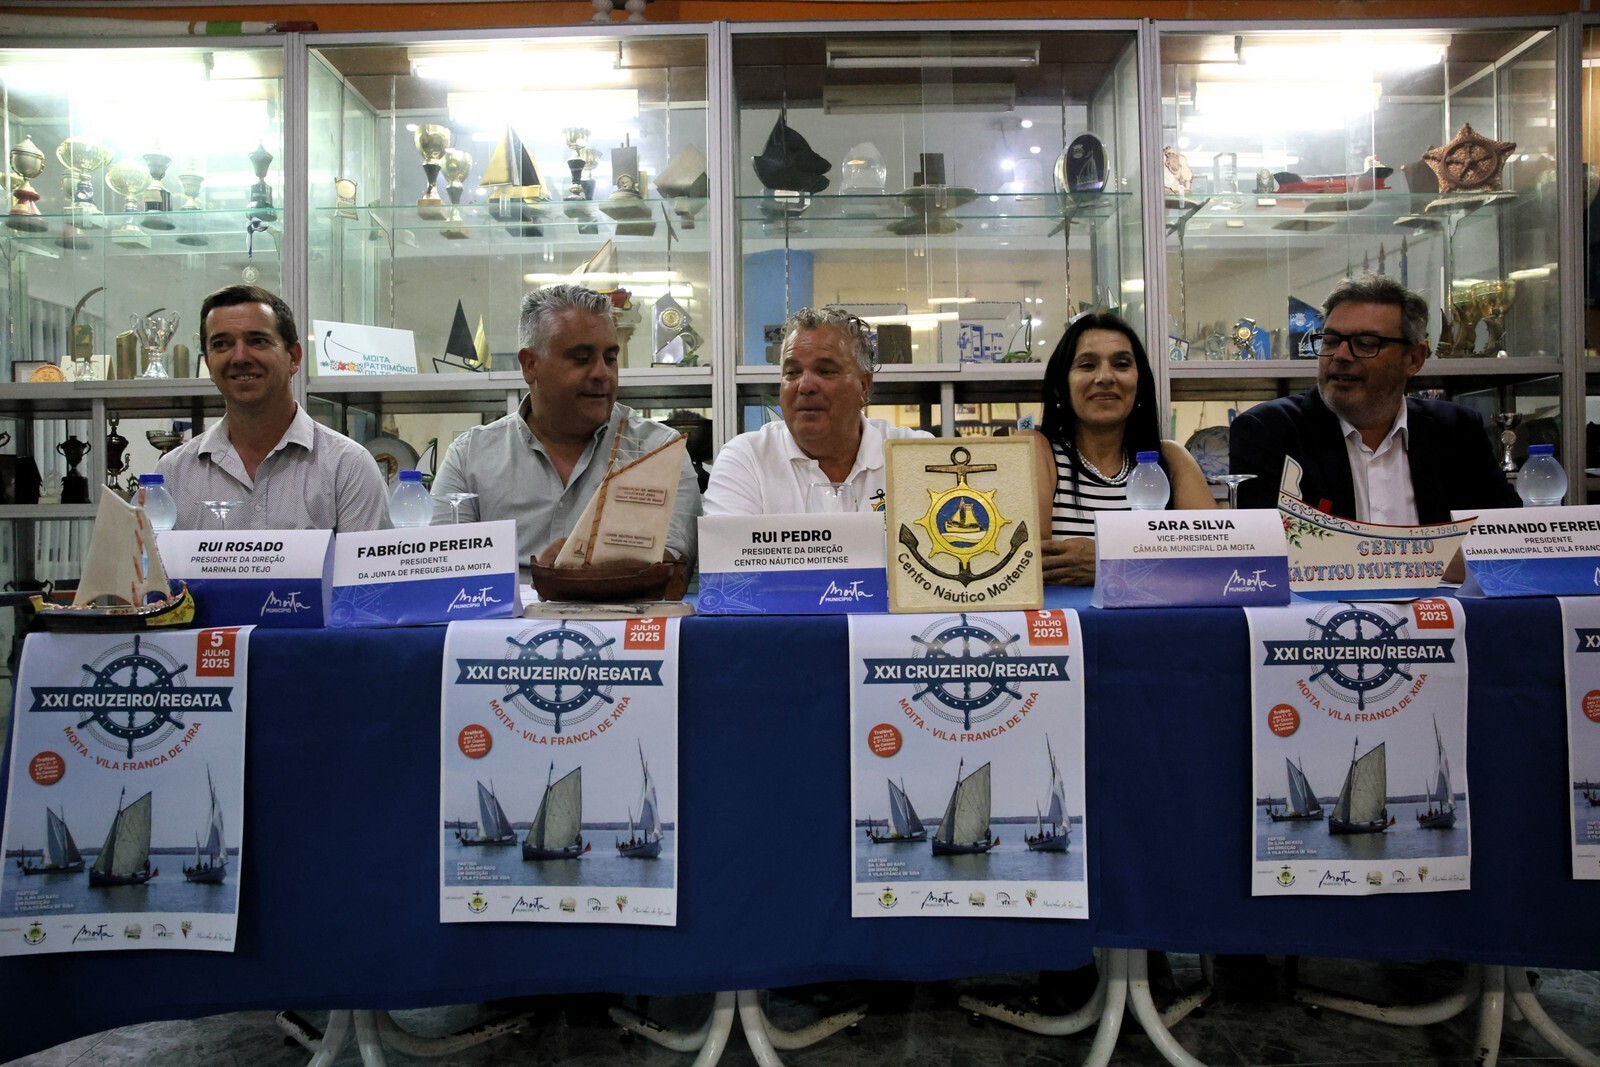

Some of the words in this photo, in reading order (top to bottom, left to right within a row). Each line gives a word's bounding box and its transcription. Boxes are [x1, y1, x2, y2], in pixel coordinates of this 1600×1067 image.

[363, 354, 390, 363] MOITA
[364, 362, 416, 373] PATRIMÓNIO
[1148, 520, 1189, 530] SARA
[1193, 520, 1235, 530] SILVA
[1470, 522, 1547, 535] FERNANDO
[752, 532, 777, 543] RUI
[781, 530, 832, 542] PEDRO
[198, 542, 222, 552] RUI
[225, 542, 283, 552] ROSADO
[358, 541, 425, 558] FABRÍCIO
[430, 537, 493, 552] PEREIRA
[742, 547, 792, 555] PRESIDENTE
[808, 544, 843, 554] DIREÇÃO
[1133, 544, 1168, 552] CÂMARA
[1357, 539, 1434, 556] CENTRO
[1466, 547, 1499, 556] CÂMARA
[1500, 546, 1542, 554] MUNICIPAL
[252, 555, 284, 564] DIREÇÃO
[400, 556, 448, 566] PRESIDENTE
[734, 558, 767, 566] CENTRO
[770, 556, 805, 565] NÁUTICO
[807, 556, 848, 564] MOITENSE
[371, 570, 396, 578] JUNTA
[410, 566, 453, 575] FREGUESIA
[468, 562, 492, 570] MOITA
[1358, 560, 1444, 579] MOITENSE
[898, 552, 932, 591] Centro
[934, 585, 986, 603] Náutico
[986, 550, 1033, 598] Moitense
[1223, 568, 1278, 596] Moita
[447, 586, 502, 612] Moita
[819, 580, 874, 605] Moita
[260, 591, 311, 616] Moita
[1418, 602, 1445, 611] JULHO
[1420, 611, 1448, 622] 2025
[631, 624, 660, 632] JULHO
[1032, 620, 1062, 628] JULHO
[210, 630, 223, 647] 5
[630, 632, 660, 642] 2025
[1033, 628, 1062, 638] 2025
[202, 648, 230, 657] JULHO
[1274, 647, 1298, 660] XXI
[1302, 644, 1445, 661] CRUZEIRO/REGATA
[202, 658, 230, 669] 2025
[466, 666, 495, 680] XXI
[497, 664, 652, 682] CRUZEIRO/REGATA
[874, 665, 901, 679] XXI
[904, 662, 1059, 679] CRUZEIRO/REGATA
[41, 693, 69, 708] XXI
[72, 690, 222, 708] CRUZEIRO/REGATA
[1296, 678, 1322, 710] MOITA
[1328, 706, 1352, 722] VILA
[1355, 707, 1399, 722] FRANCA
[1399, 698, 1414, 712] DE
[1410, 673, 1428, 698] XIRA
[488, 698, 515, 732] MOITA
[522, 728, 548, 746] VILA
[550, 728, 598, 746] FRANCA
[598, 718, 614, 734] DE
[609, 695, 632, 720] XIRA
[898, 698, 924, 730] MOITA
[932, 726, 958, 742] VILA
[960, 726, 1006, 742] FRANCA
[1006, 714, 1022, 732] DE
[1018, 691, 1039, 716] XIRA
[64, 726, 88, 758] MOITA
[95, 754, 120, 771] VILA
[122, 754, 168, 772] FRANCA
[168, 744, 184, 760] DE
[179, 720, 202, 746] XIRA
